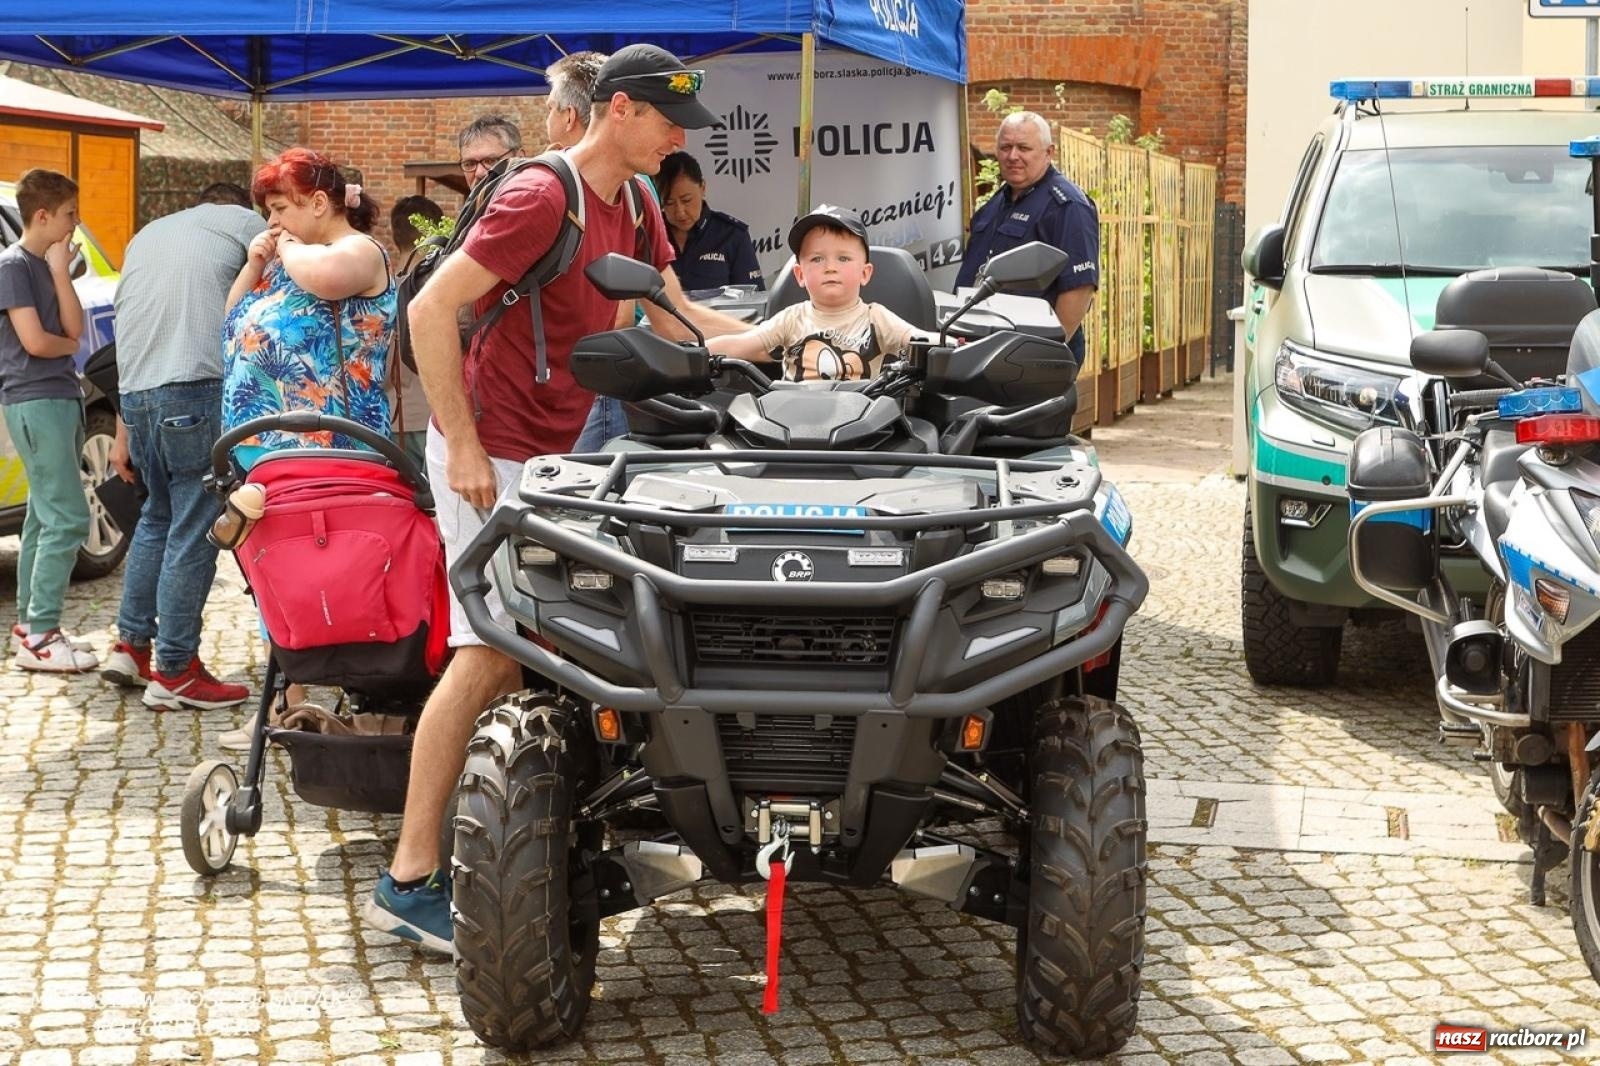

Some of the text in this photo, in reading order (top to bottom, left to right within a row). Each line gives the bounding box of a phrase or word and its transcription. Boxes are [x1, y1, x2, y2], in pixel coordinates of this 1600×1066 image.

[1429, 80, 1532, 96] STRAŻ GRANICZNA
[788, 570, 812, 579] BRP
